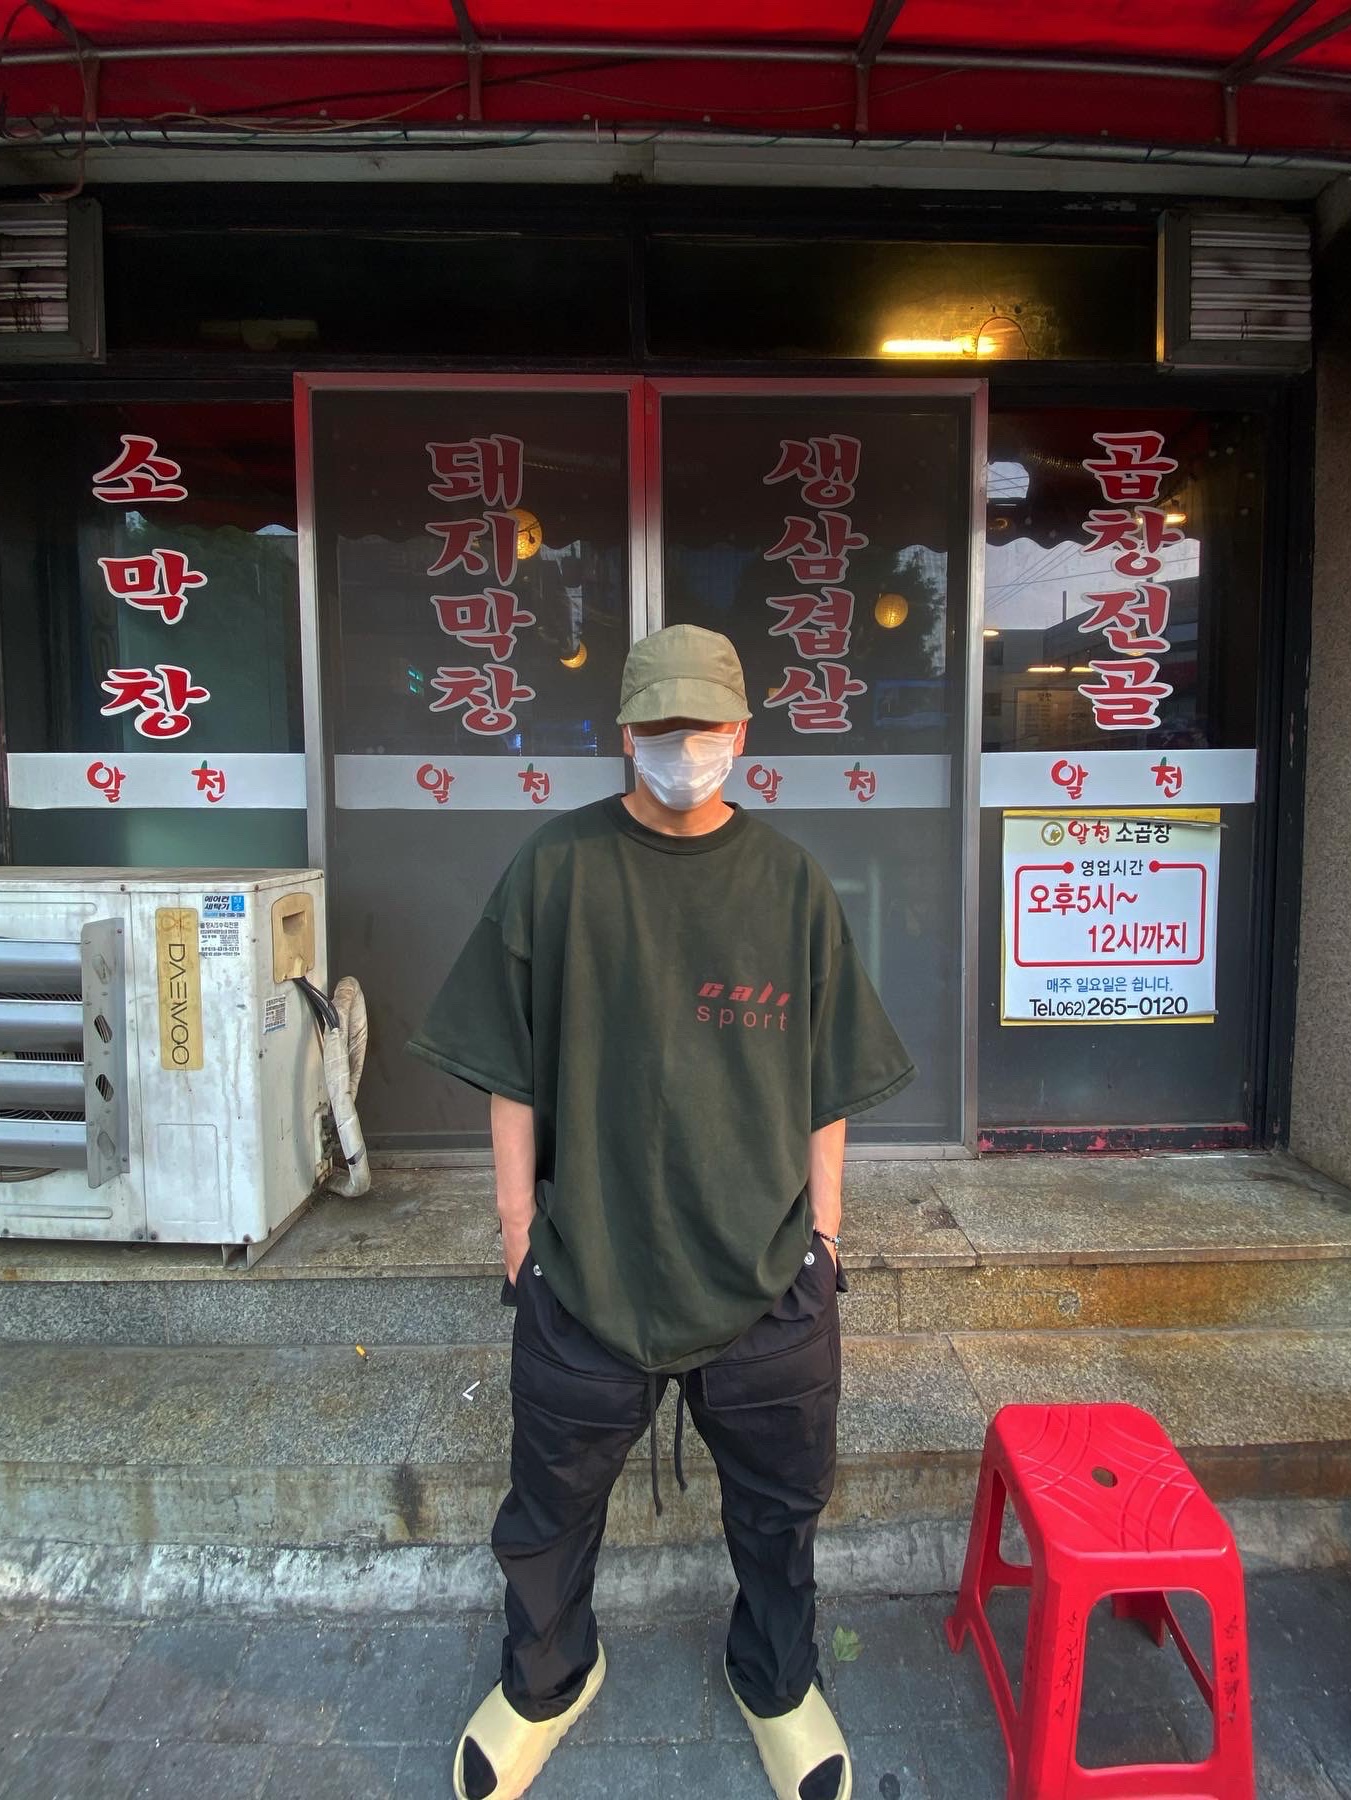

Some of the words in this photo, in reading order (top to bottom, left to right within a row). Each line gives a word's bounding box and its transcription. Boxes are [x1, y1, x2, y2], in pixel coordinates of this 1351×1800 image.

[92, 434, 211, 740] 소막창
[425, 433, 536, 736] 돼지막창
[763, 433, 869, 735] 생삼겹살
[1077, 430, 1184, 731] 곱창전골
[1067, 820, 1110, 844] 알천
[1081, 859, 1144, 877] 영업시간
[204, 895, 230, 903] 에어컨
[1087, 922, 1188, 954] 12시까지
[1046, 976, 1072, 993] 매주
[1076, 976, 1128, 993] 일요일은
[1131, 976, 1173, 993] 쉽니다.
[168, 943, 190, 1065] DAEWOO
[696, 1005, 787, 1031] sport
